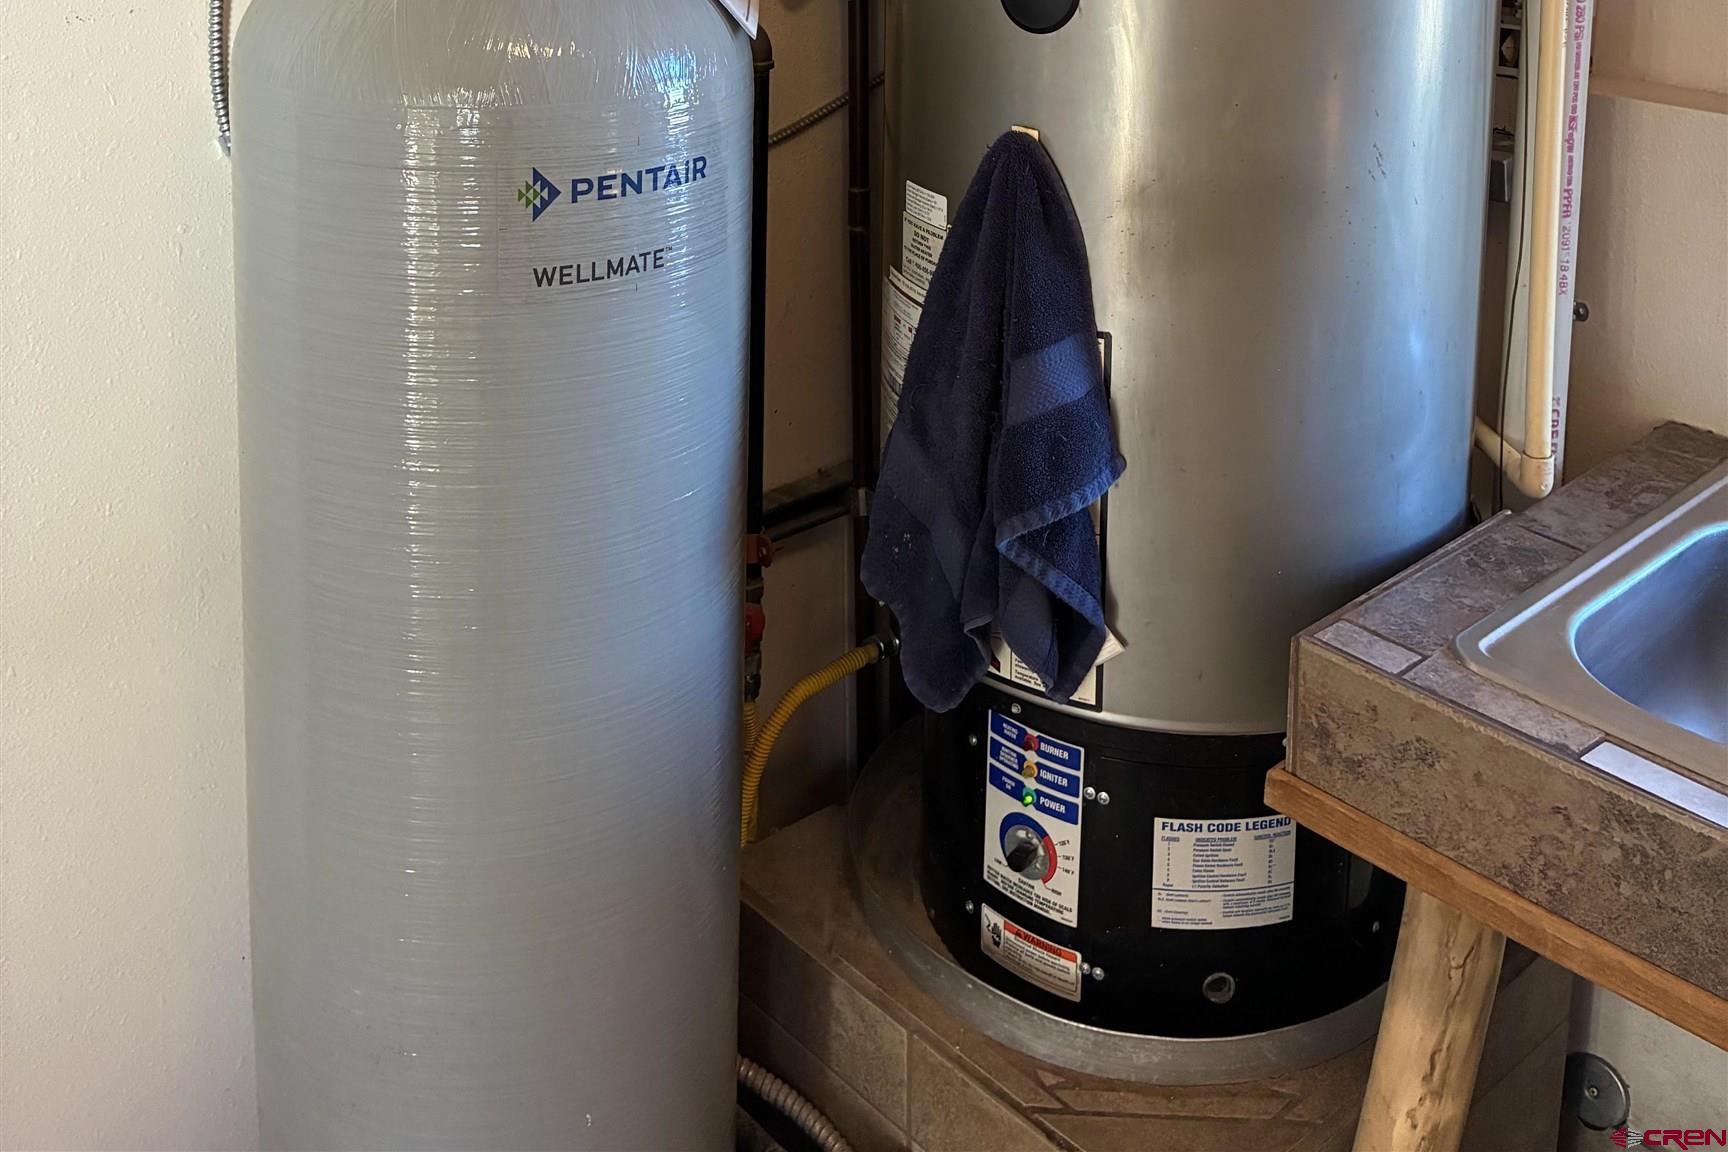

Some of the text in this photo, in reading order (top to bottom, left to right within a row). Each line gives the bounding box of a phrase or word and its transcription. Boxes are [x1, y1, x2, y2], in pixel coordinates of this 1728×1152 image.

[1574, 25, 1585, 41] PSI
[571, 156, 707, 203] PENTAIR
[1040, 742, 1069, 760] BURNER
[1040, 768, 1068, 787] IGNITER
[1040, 795, 1065, 814] POWER
[1162, 817, 1291, 832] FLASH CODE LEGEND
